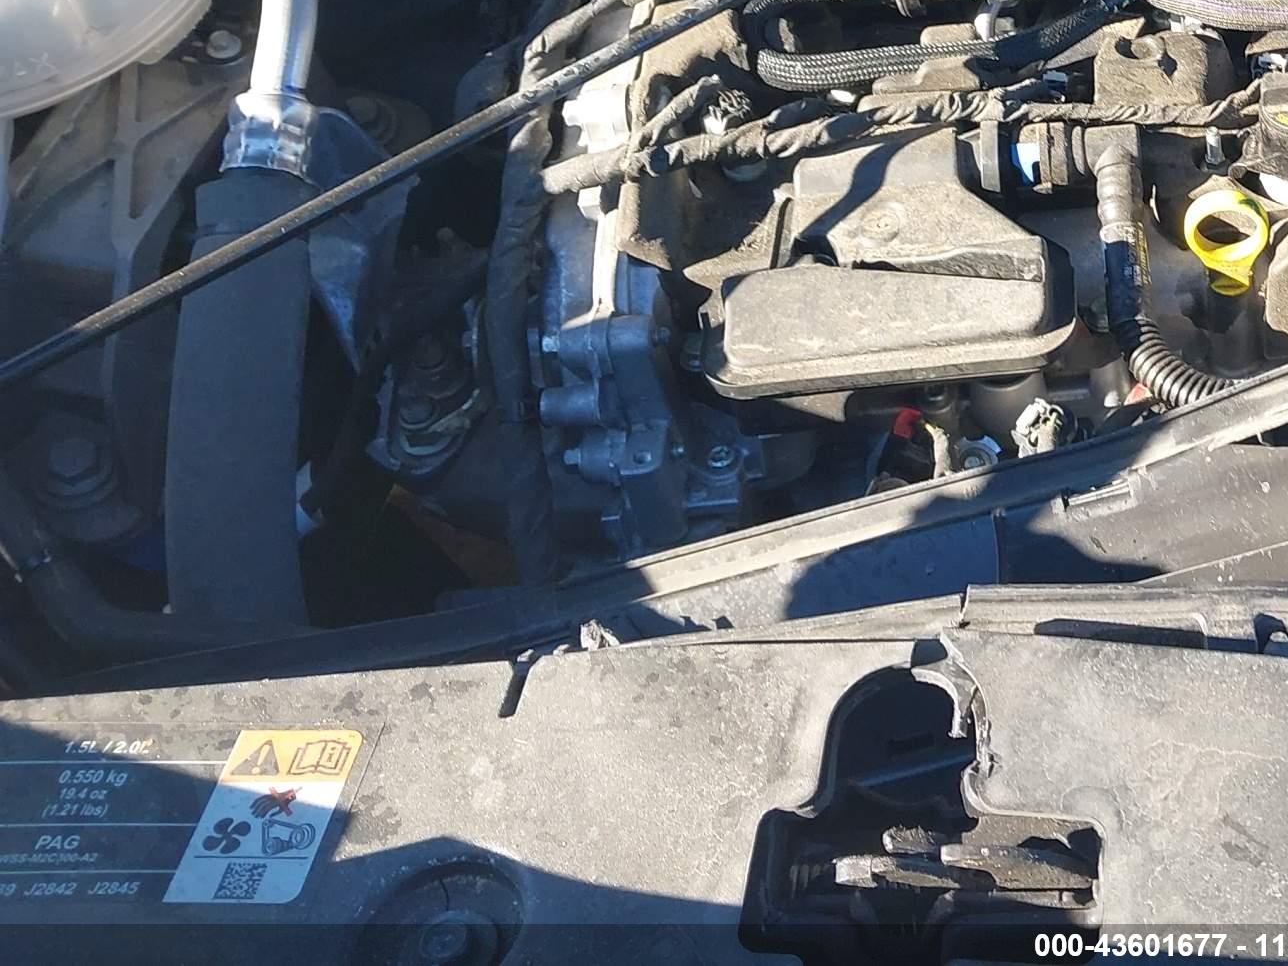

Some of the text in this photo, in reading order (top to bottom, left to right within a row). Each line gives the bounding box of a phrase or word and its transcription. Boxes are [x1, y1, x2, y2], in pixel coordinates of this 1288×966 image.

[64, 740, 98, 754] 1.5L
[58, 769, 128, 786] 0.550 kg
[59, 787, 109, 800] 19.4 oz
[42, 803, 109, 818] (1.21 lbs)
[34, 835, 81, 850] PAG
[24, 882, 77, 896] J2842
[88, 881, 141, 895] J2845
